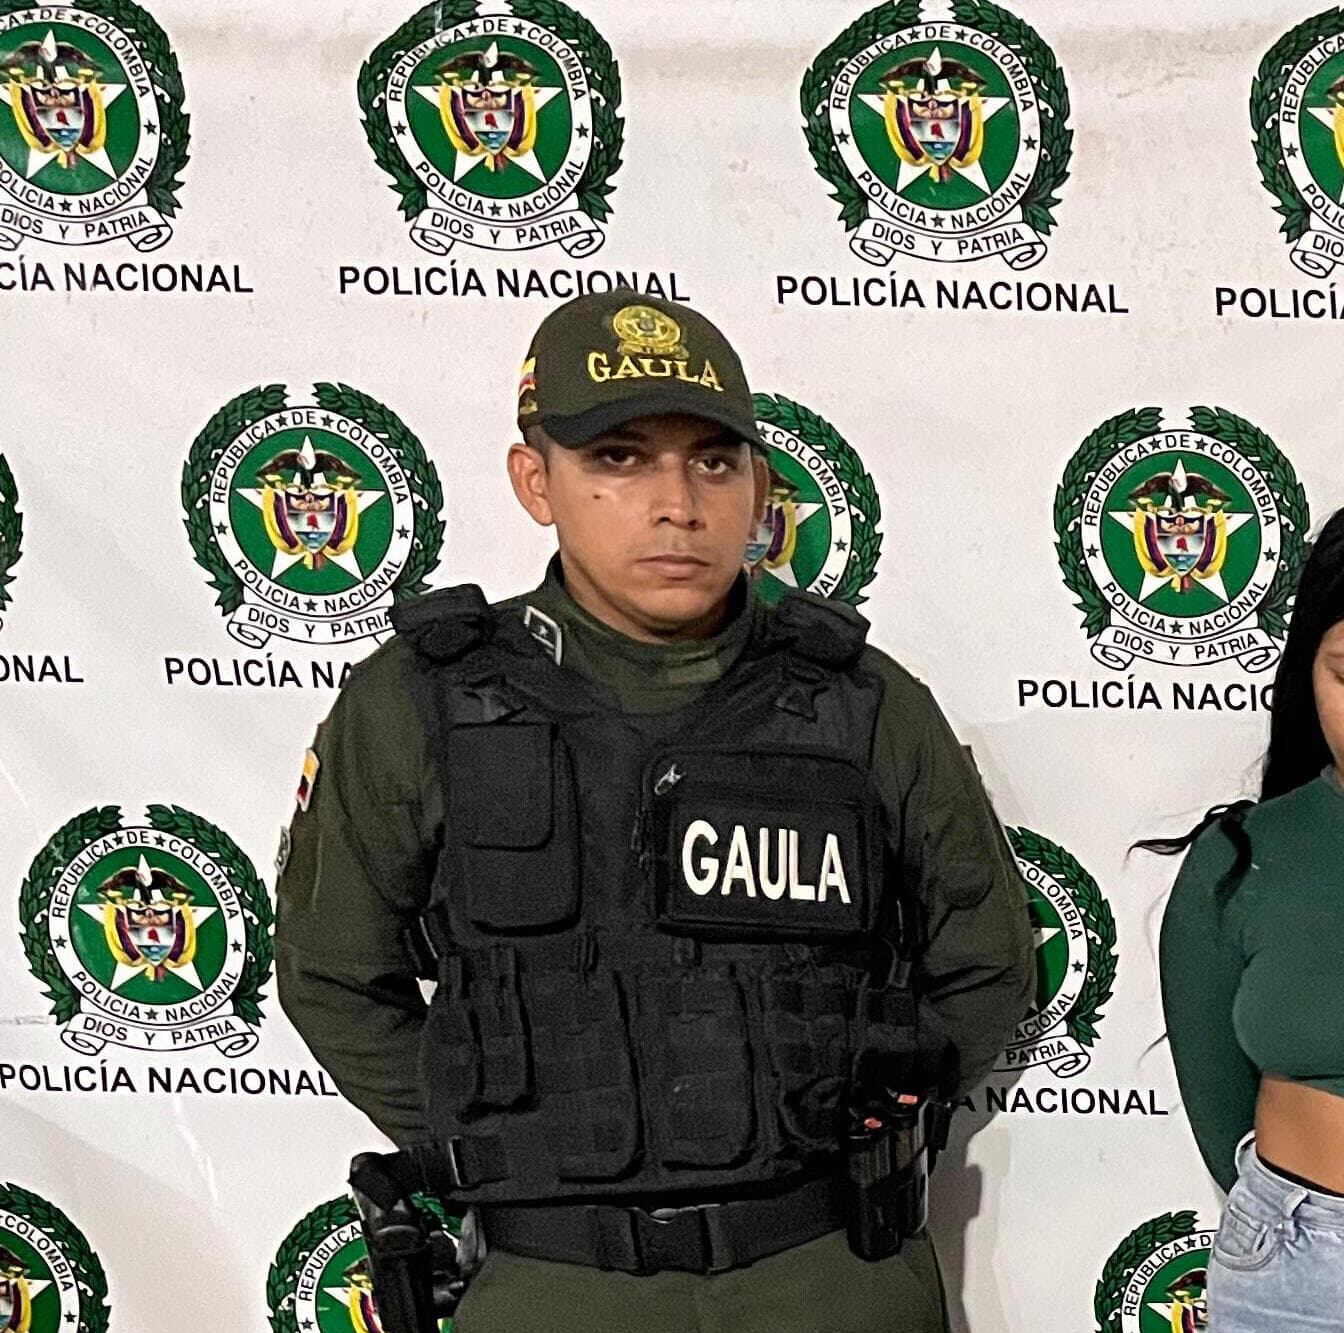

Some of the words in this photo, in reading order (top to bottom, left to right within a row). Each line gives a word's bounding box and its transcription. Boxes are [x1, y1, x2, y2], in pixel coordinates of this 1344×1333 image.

[64, 263, 253, 292] NACIONAL
[340, 259, 486, 296] POLICÍA
[777, 271, 925, 308] POLICÍA
[937, 280, 1128, 313] NACIONAL
[588, 351, 724, 392] GAULA
[212, 421, 277, 503] REPUBLICA
[291, 411, 317, 425] DE
[336, 417, 408, 504] COLOMBIA
[1084, 444, 1149, 526] REPUBLICA
[1165, 434, 1190, 448] DE
[1210, 440, 1276, 526] COLOMBIA
[234, 560, 301, 610] POLICIA
[324, 558, 402, 613] NACIONAL
[248, 608, 288, 632] DIOS
[305, 623, 317, 638] Y
[331, 611, 396, 638] PATRIA
[1102, 583, 1166, 632] POLICIA
[1190, 580, 1267, 635] NACIONAL
[1113, 630, 1153, 654] DIOS
[1169, 645, 1181, 659] Y
[1195, 633, 1259, 660] PATRIA
[165, 652, 303, 688] POLICÍA
[1018, 674, 1162, 709] POLICÍA
[52, 840, 115, 918] REPUBLICA
[126, 830, 151, 844] DE
[169, 837, 239, 919] COLOMBIA
[682, 819, 851, 904] GAULA
[72, 971, 141, 1019] POLICIA
[165, 970, 240, 1022] NACIONAL
[84, 1017, 127, 1040] DIOS
[144, 1032, 157, 1045] Y
[172, 1020, 236, 1045] PATRIA
[0, 1059, 137, 1092] POLICÍA
[148, 1066, 339, 1097] NACIONAL
[986, 1087, 1168, 1115] NACIONAL
